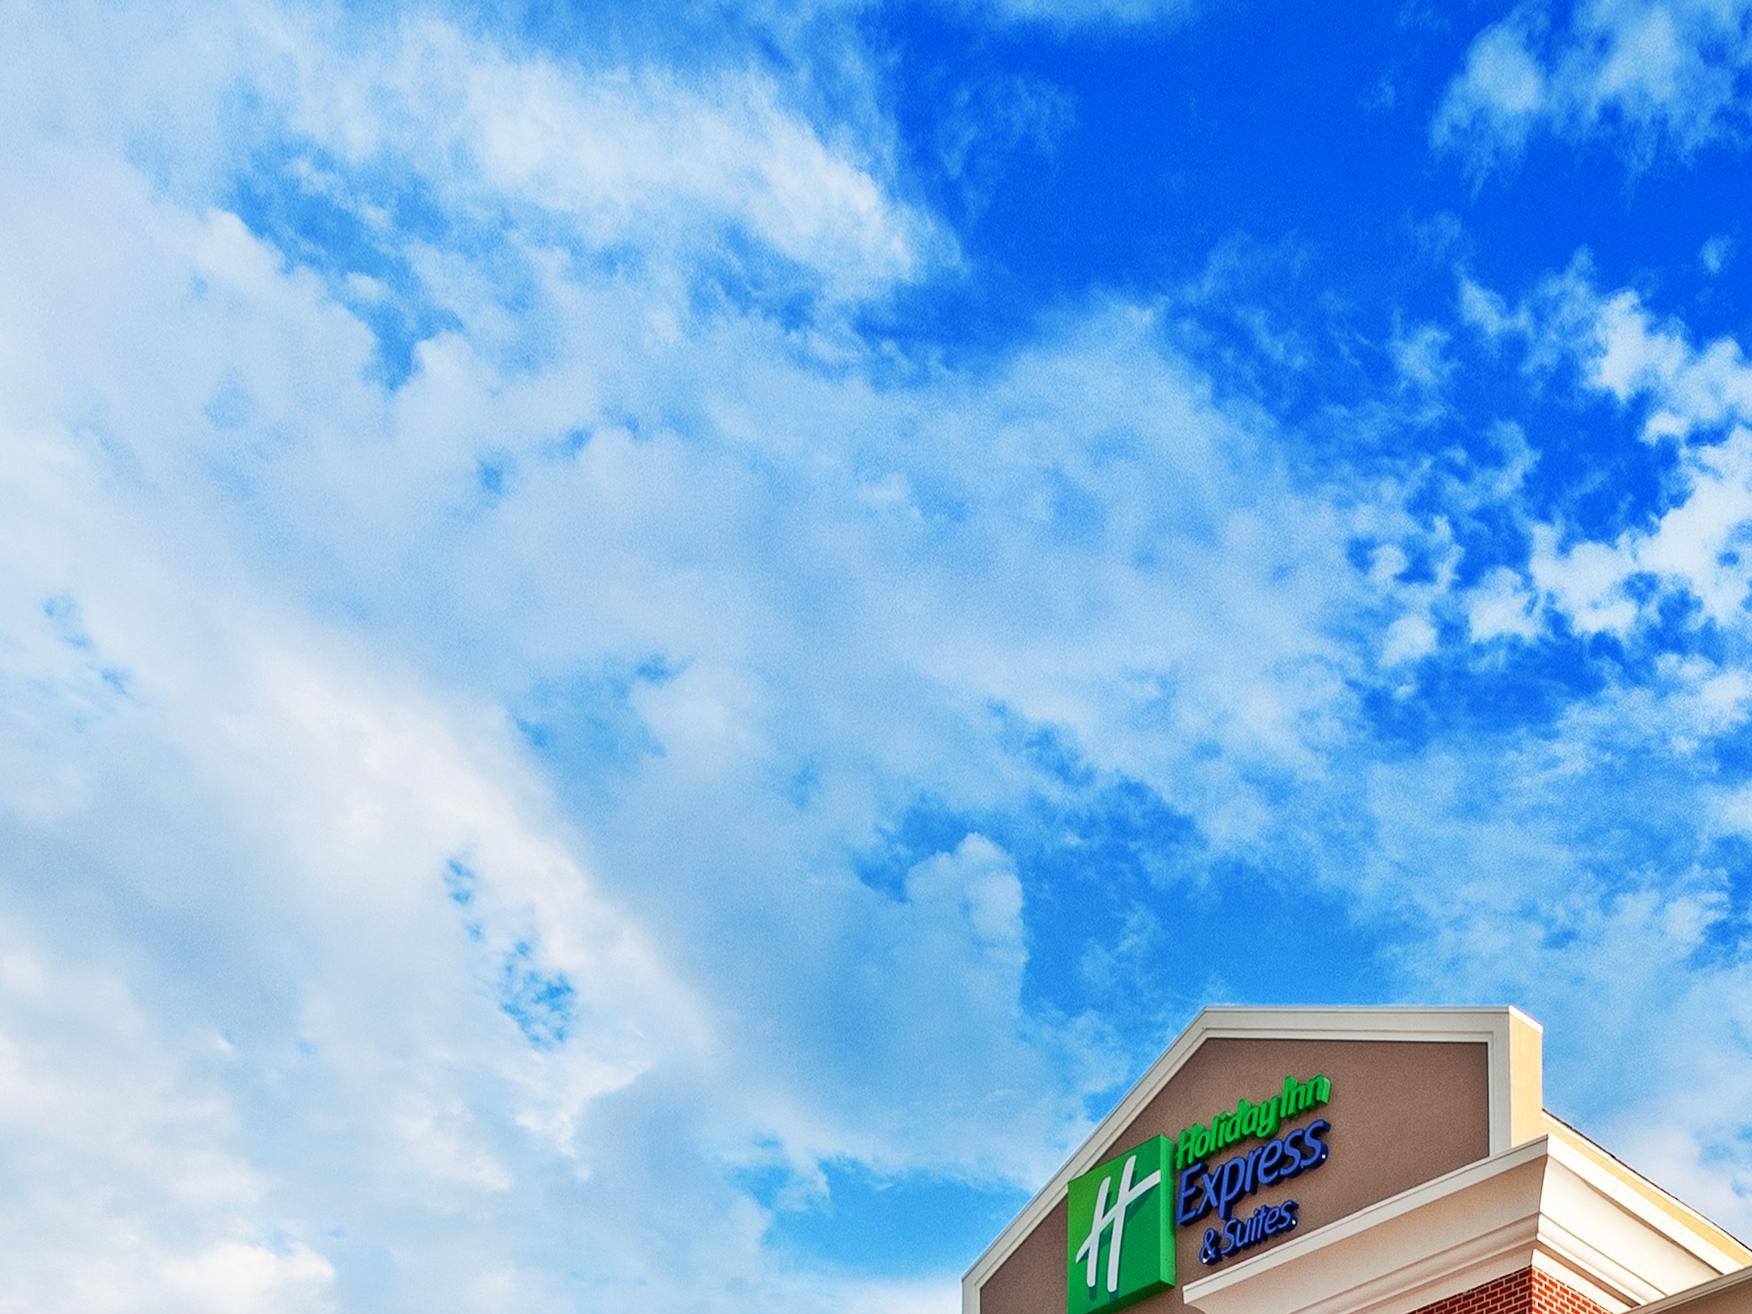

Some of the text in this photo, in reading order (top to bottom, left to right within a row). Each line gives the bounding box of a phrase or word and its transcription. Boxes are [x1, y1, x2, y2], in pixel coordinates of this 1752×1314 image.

[1176, 1074, 1332, 1171] Holiday Inn
[1177, 1119, 1331, 1226] Express
[1199, 1200, 1298, 1265] & Suites
